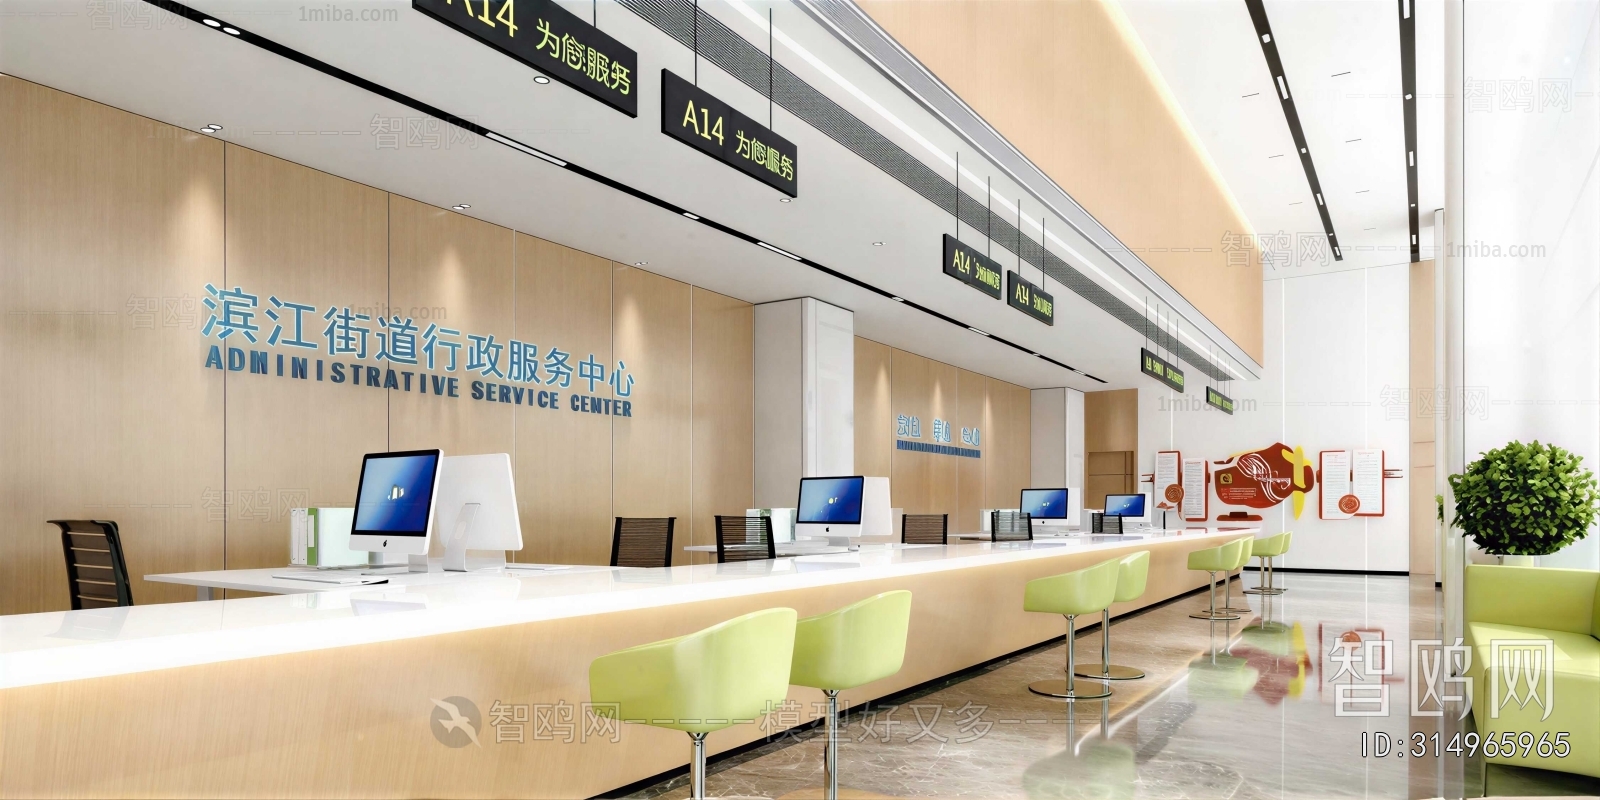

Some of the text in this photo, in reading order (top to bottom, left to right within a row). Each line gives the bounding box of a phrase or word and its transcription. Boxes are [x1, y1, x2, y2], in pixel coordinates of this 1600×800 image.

[683, 100, 724, 146] A14
[953, 249, 970, 274] A14
[201, 283, 635, 398] 滨江街道行政服务中心
[471, 380, 559, 410] SERVICE
[570, 394, 632, 418] CENTER
